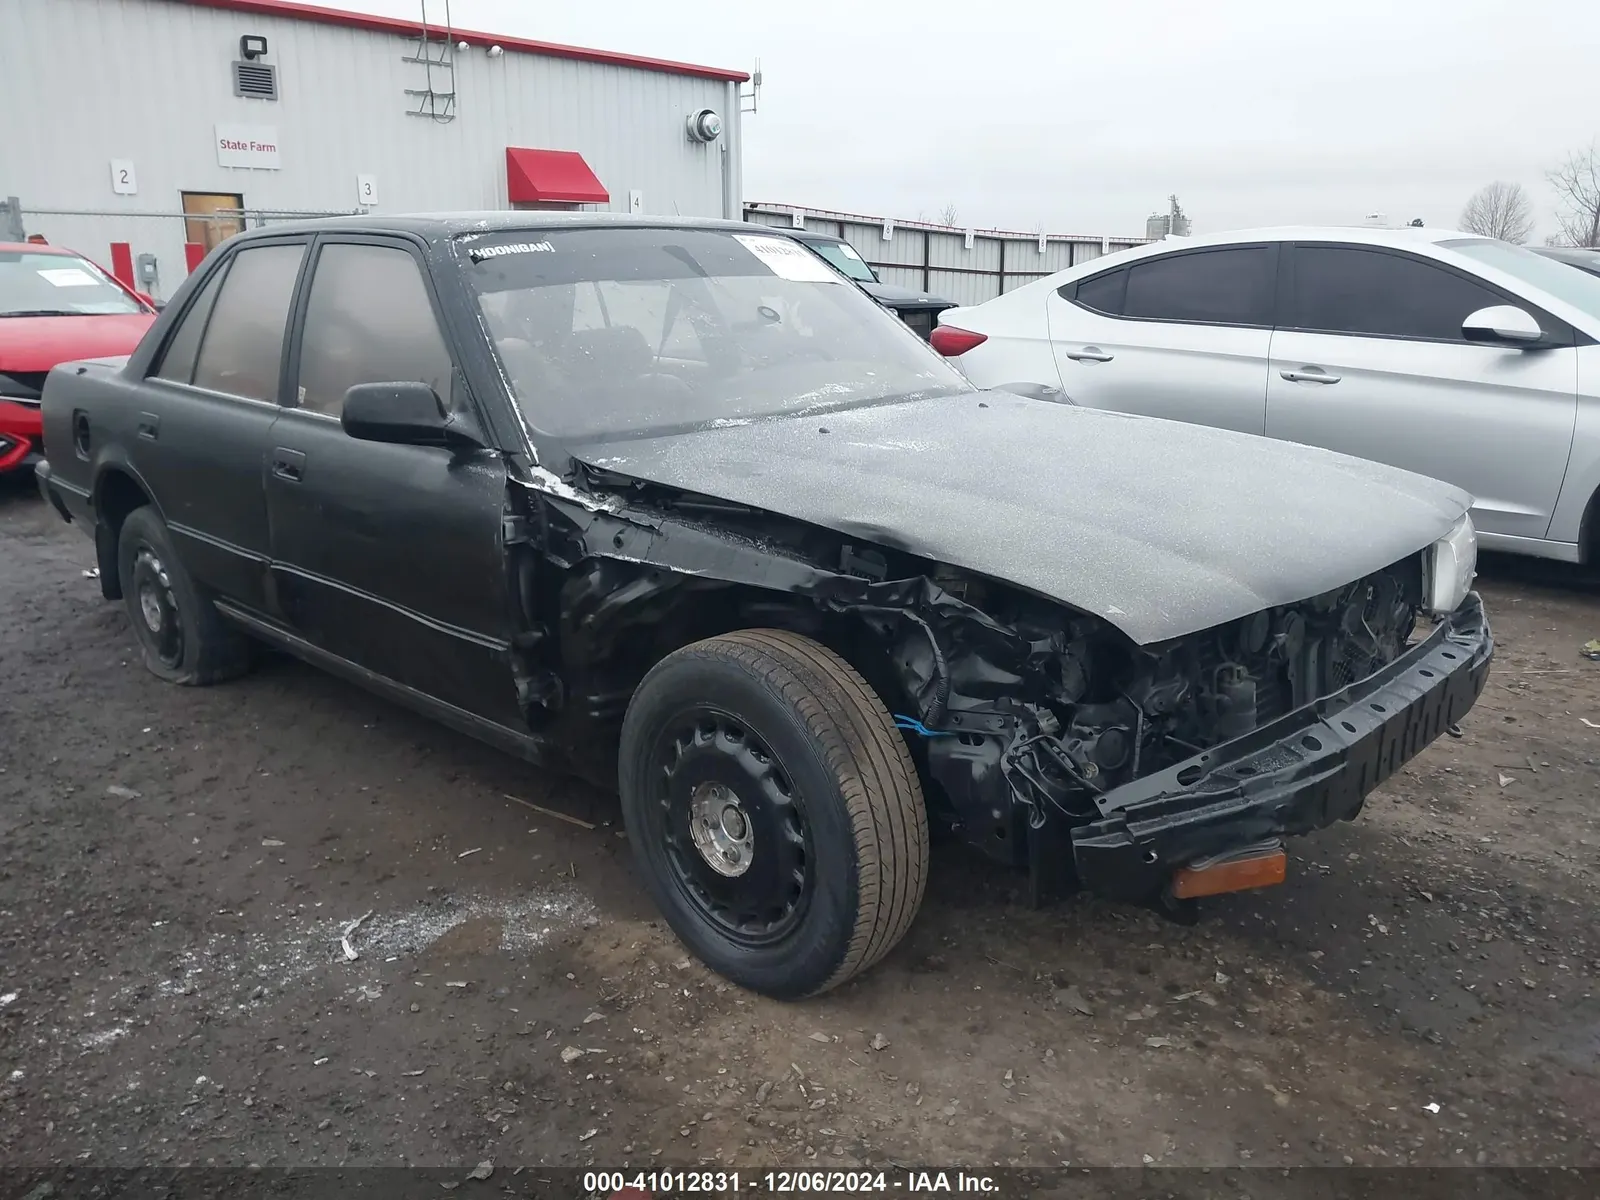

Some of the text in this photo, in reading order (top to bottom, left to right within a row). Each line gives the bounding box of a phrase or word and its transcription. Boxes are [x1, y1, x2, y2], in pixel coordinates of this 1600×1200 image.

[220, 139, 277, 153] State Farm
[119, 169, 129, 184] 2
[364, 182, 372, 196] 3
[634, 196, 640, 208] 4
[796, 215, 801, 226] 5
[886, 225, 891, 235] 6
